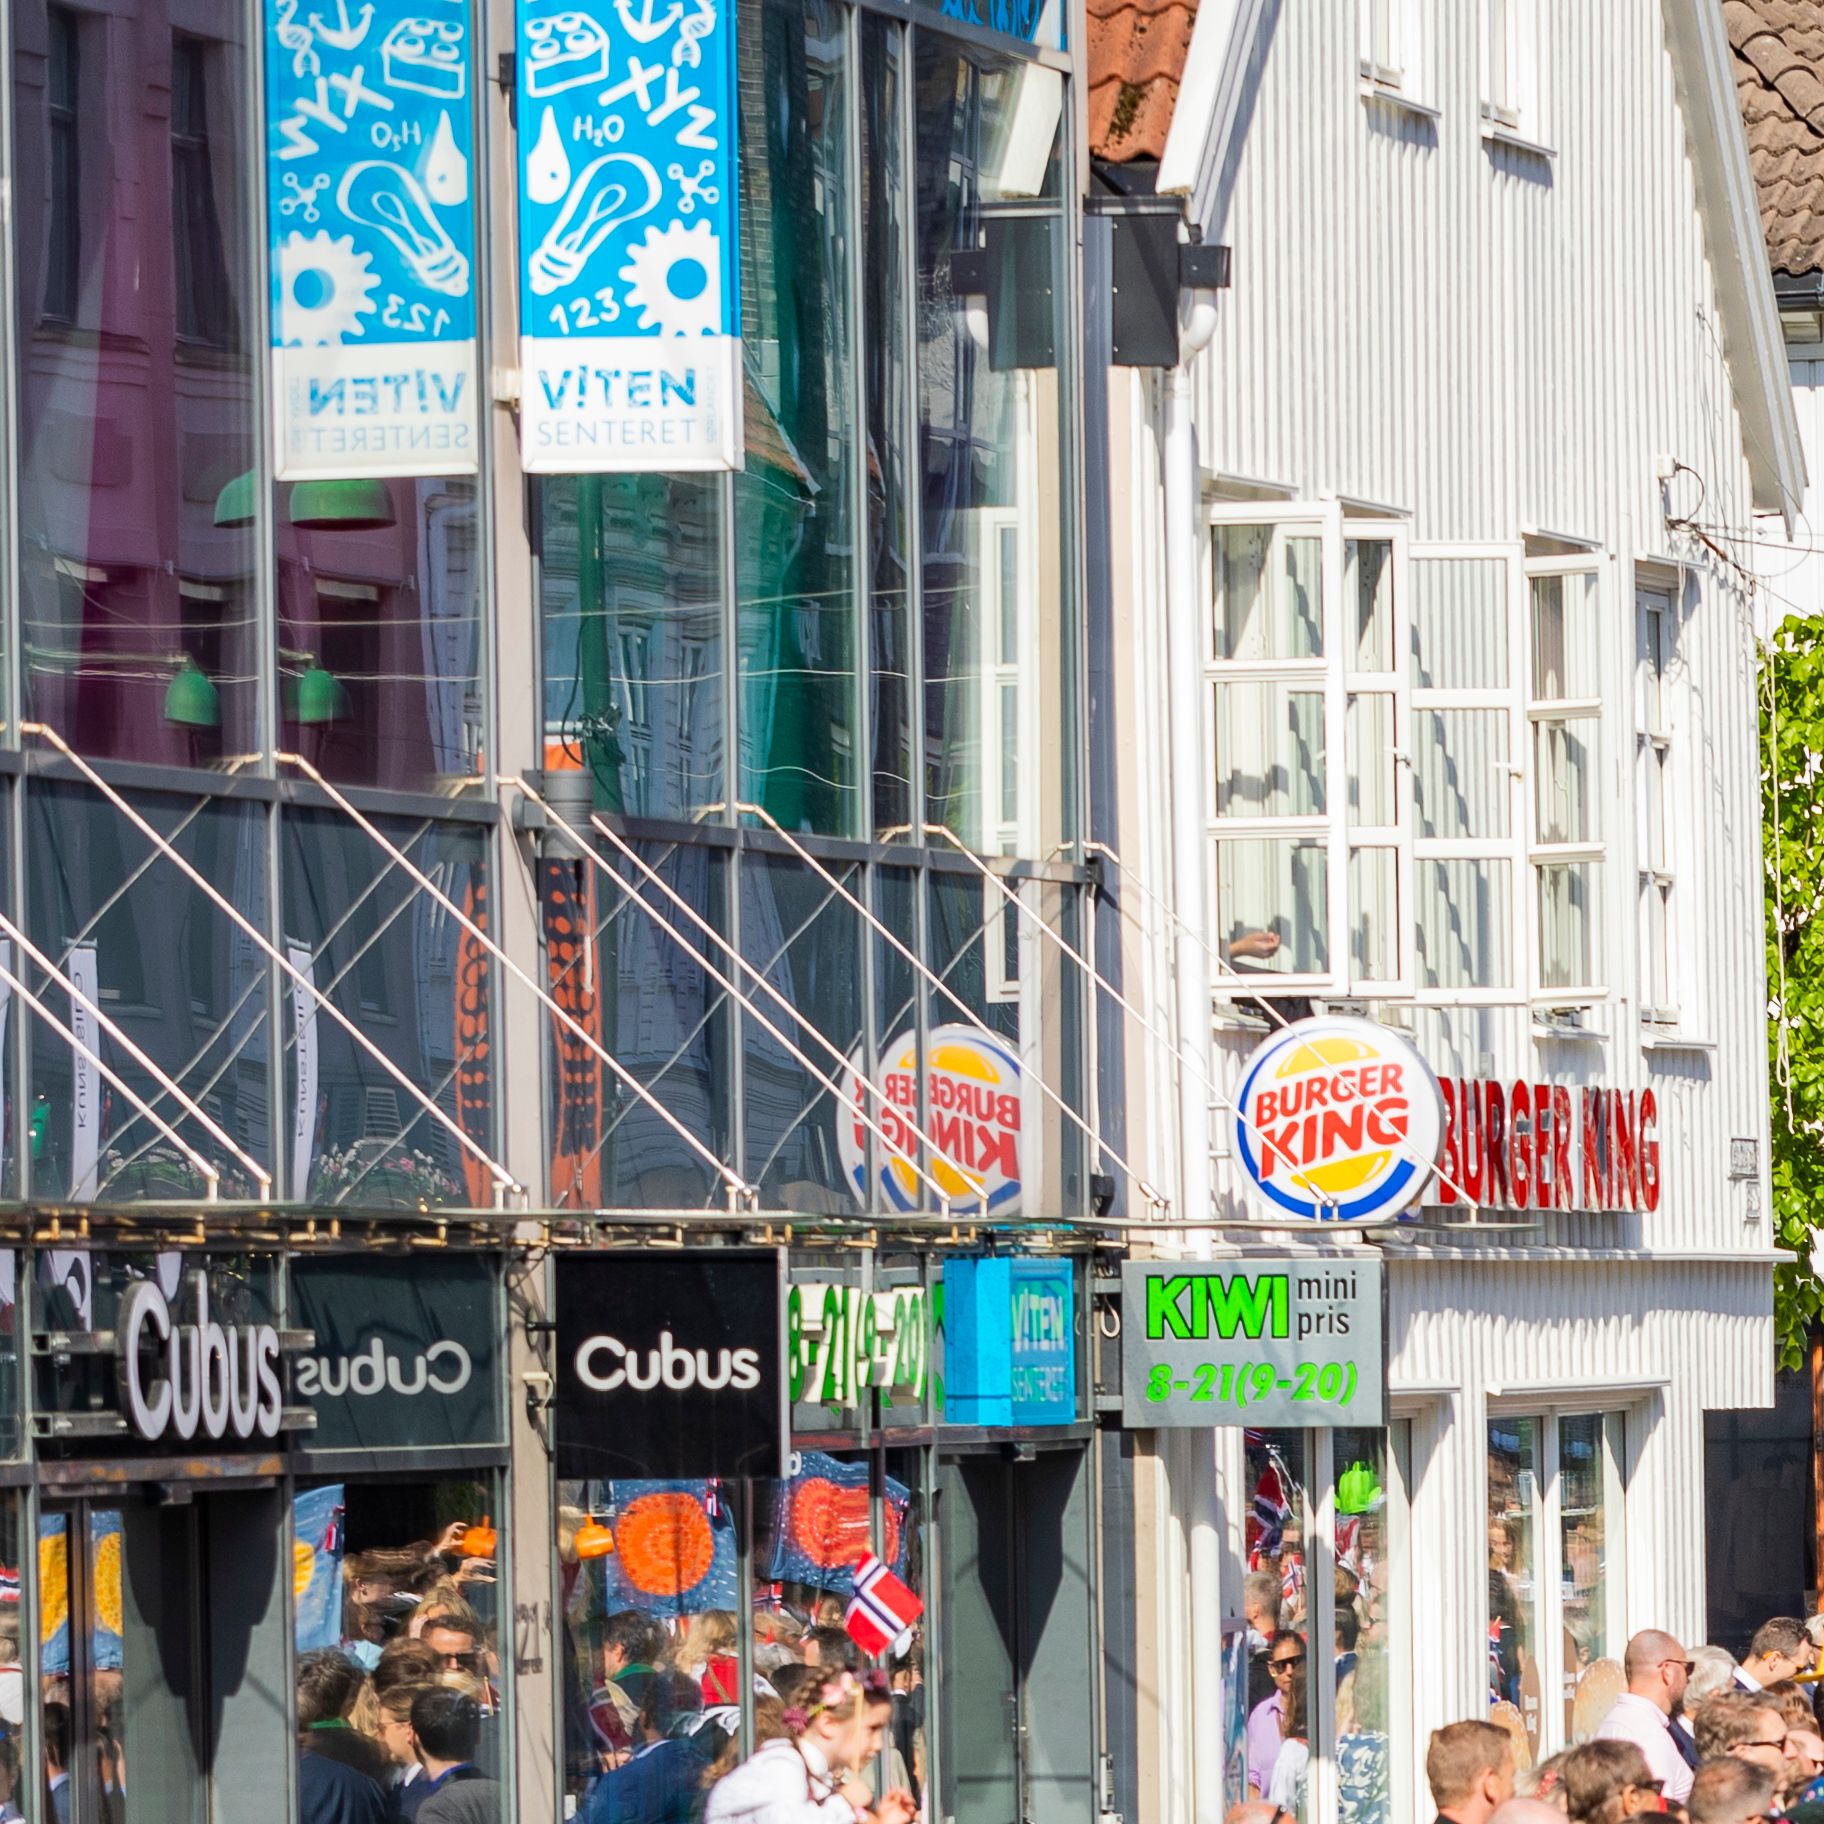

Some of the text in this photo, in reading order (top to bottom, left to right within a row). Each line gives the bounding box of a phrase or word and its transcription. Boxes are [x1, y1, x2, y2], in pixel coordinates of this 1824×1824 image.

[549, 287, 620, 334] 123
[538, 419, 697, 447] SENTERET
[1256, 1063, 1404, 1125] BURGER
[1259, 1098, 1410, 1181] KING
[1438, 1076, 1661, 1213] BURGER KING
[1146, 1275, 1290, 1340] KIWI
[1298, 1271, 1356, 1300] mini
[1298, 1307, 1350, 1340] pris
[124, 1272, 284, 1440] Cubus
[574, 1331, 761, 1391] Cubus
[1148, 1361, 1358, 1408] 8-21(9-20)
